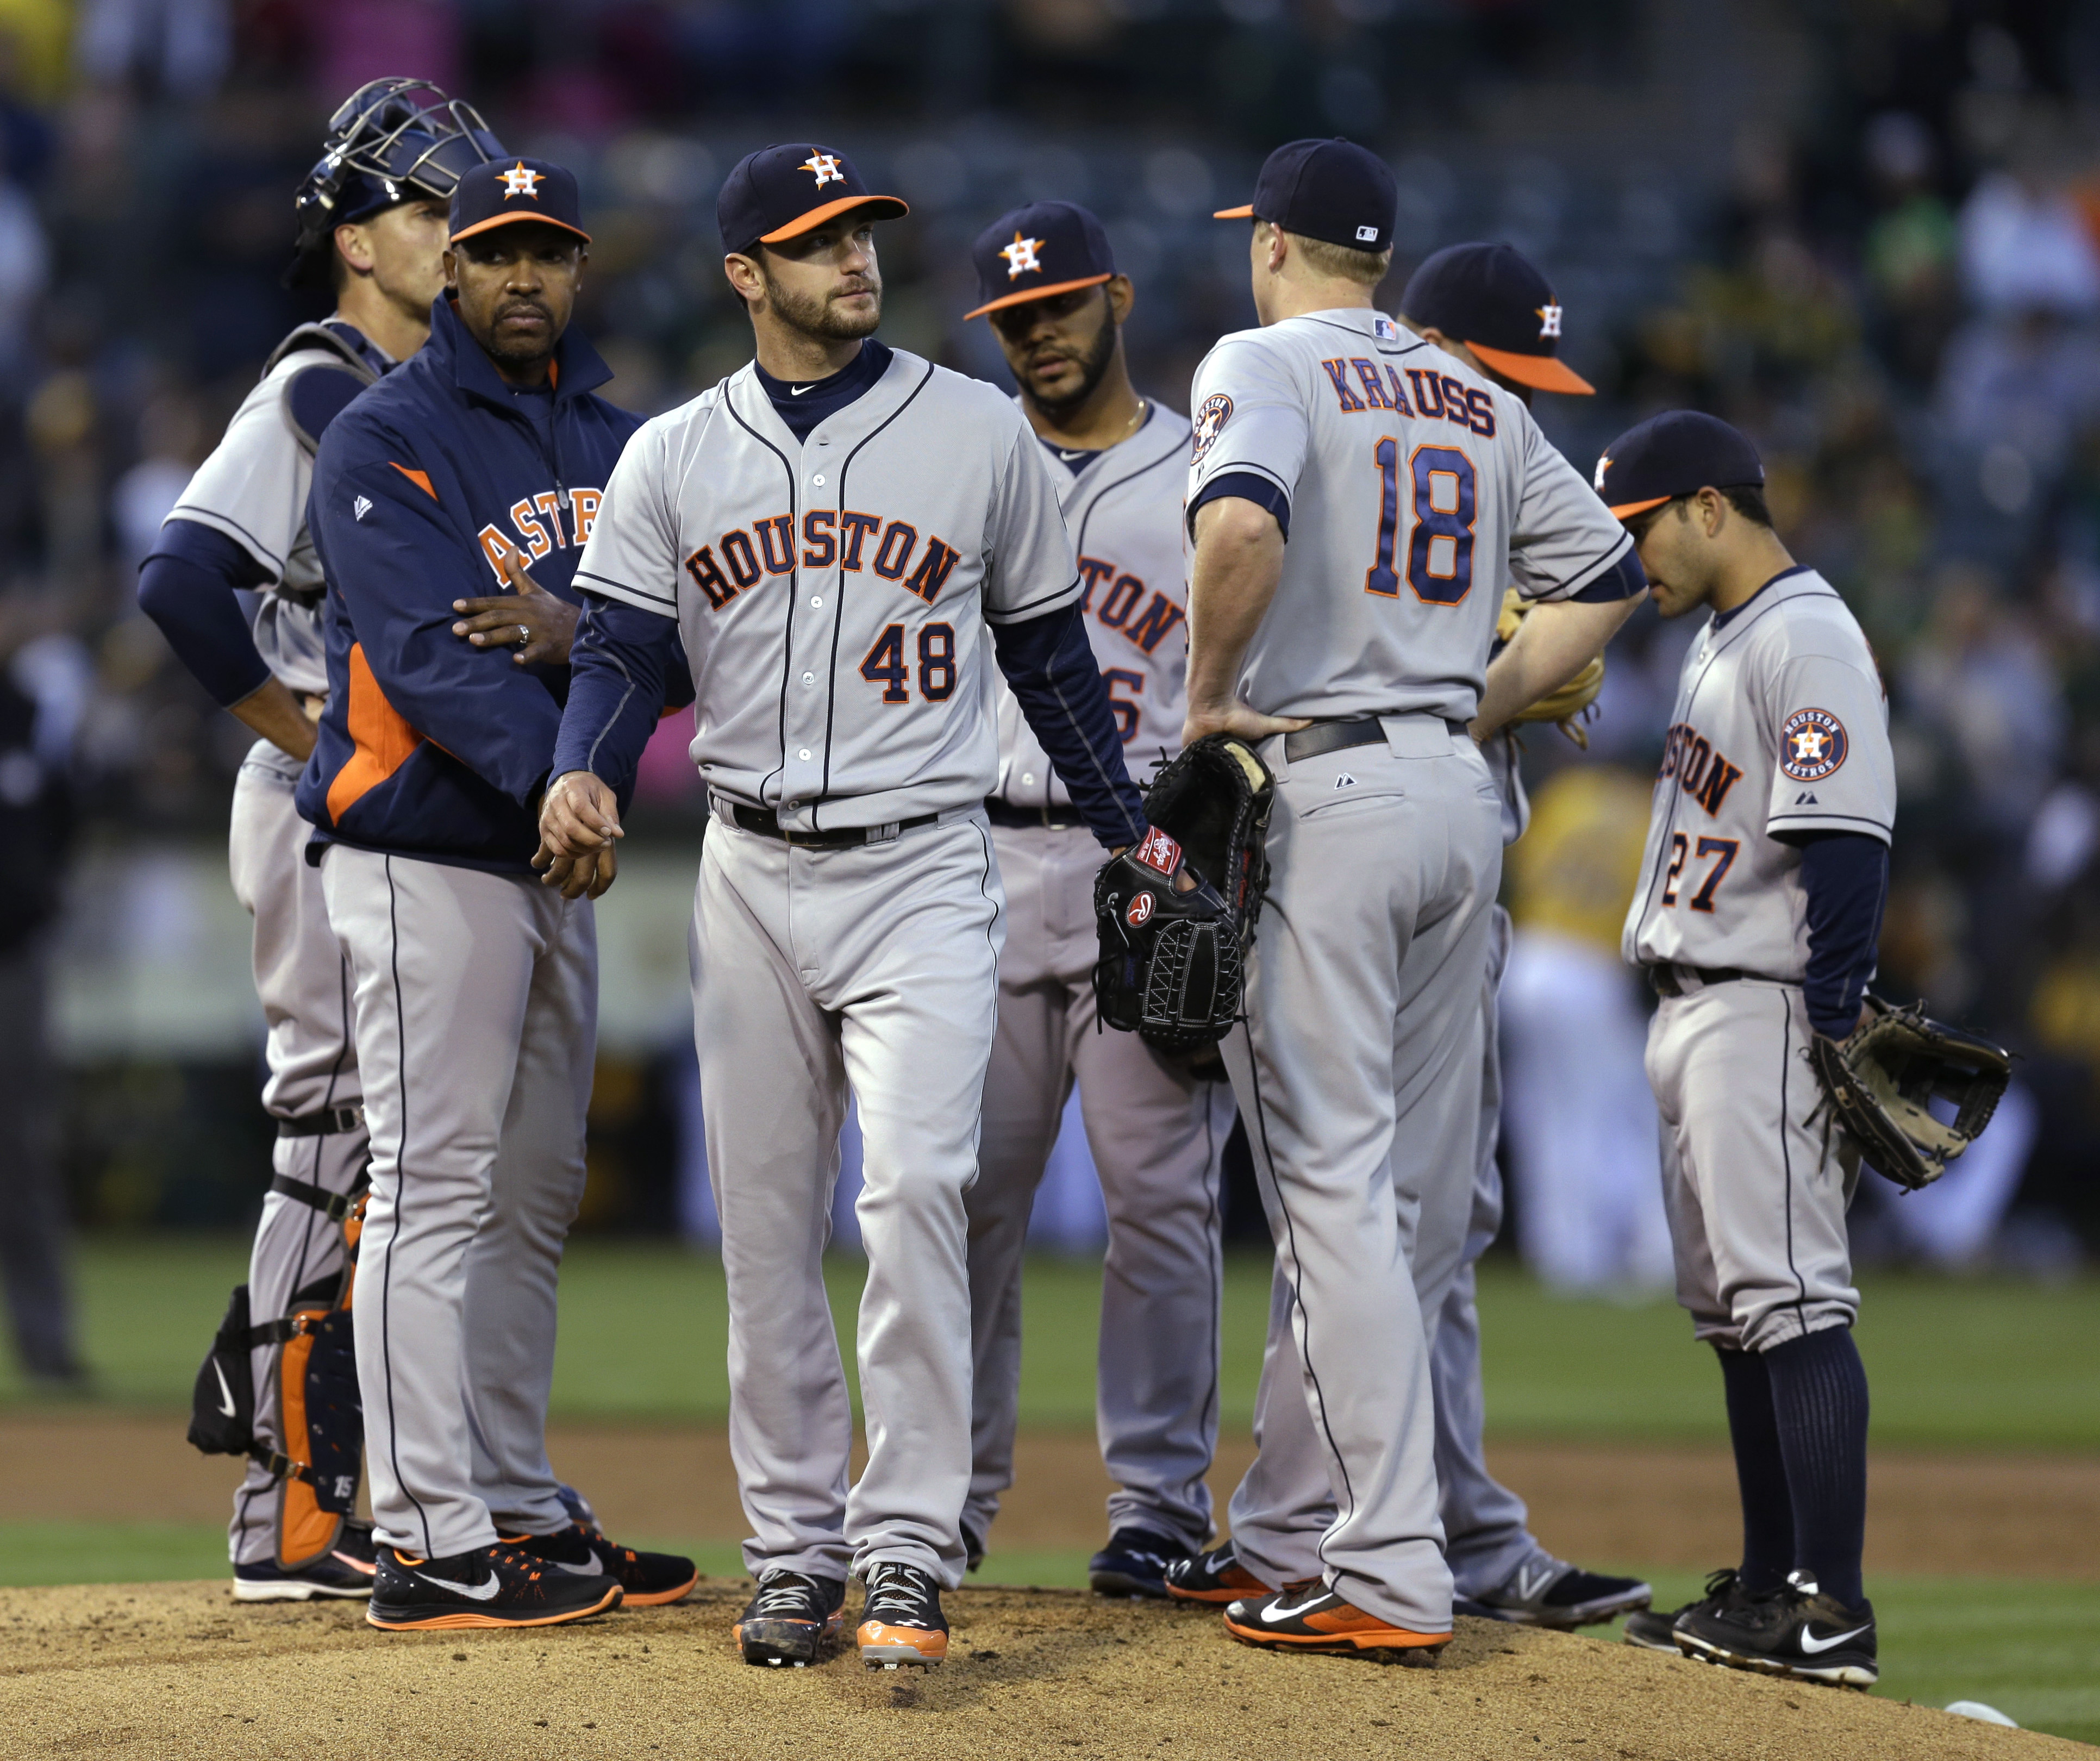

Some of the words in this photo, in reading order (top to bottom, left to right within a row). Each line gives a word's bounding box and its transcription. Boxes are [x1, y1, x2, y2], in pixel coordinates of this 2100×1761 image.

[504, 168, 538, 195] H
[805, 155, 844, 184] H
[1004, 238, 1040, 275] H
[1195, 398, 1226, 434] HOUSTON
[1321, 358, 1496, 439] KRAUSS
[477, 488, 604, 589] ASTR
[1365, 435, 1478, 607] 18
[685, 509, 961, 612] HOUSTON
[858, 621, 956, 703] 48
[1784, 711, 1840, 734] HOUSTON
[1796, 733, 1823, 758] H
[1785, 759, 1835, 777] ASTROS
[1661, 832, 1741, 914] 27
